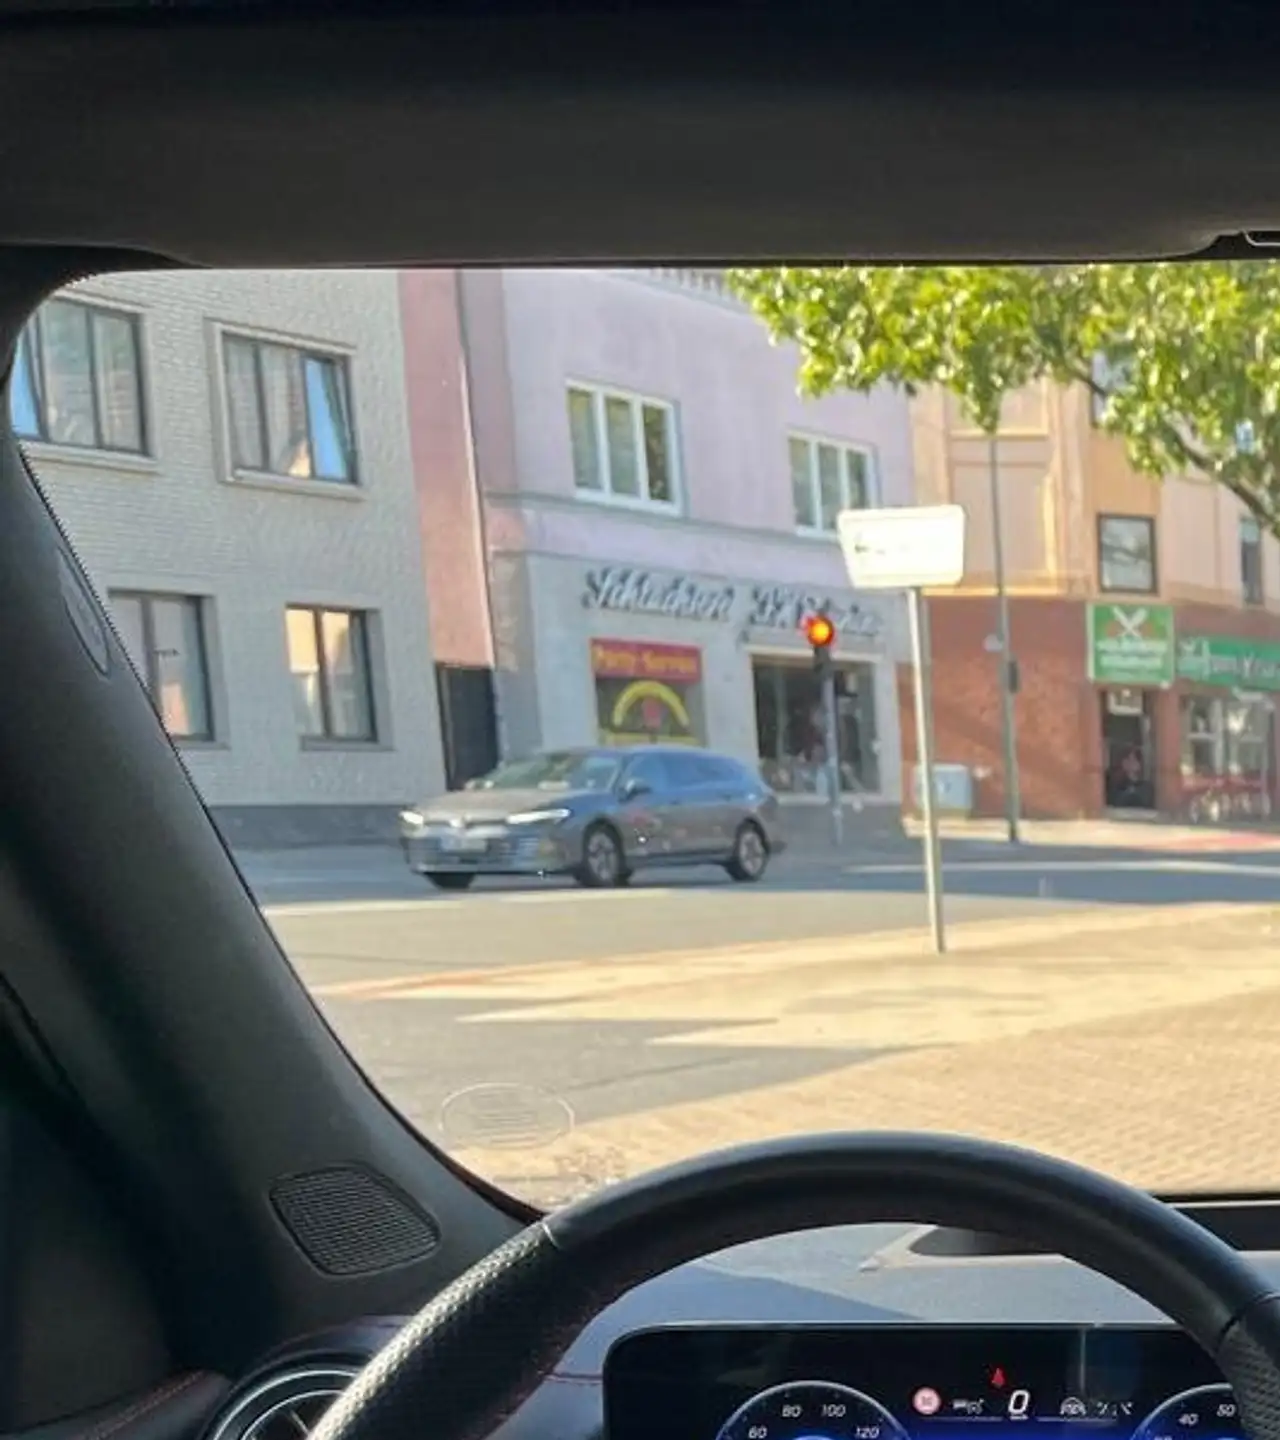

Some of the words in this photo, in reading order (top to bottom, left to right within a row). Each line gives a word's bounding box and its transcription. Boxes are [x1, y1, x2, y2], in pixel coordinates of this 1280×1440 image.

[1008, 1389, 1031, 1414] 0
[821, 1404, 846, 1418] 100
[854, 1425, 880, 1440] 120
